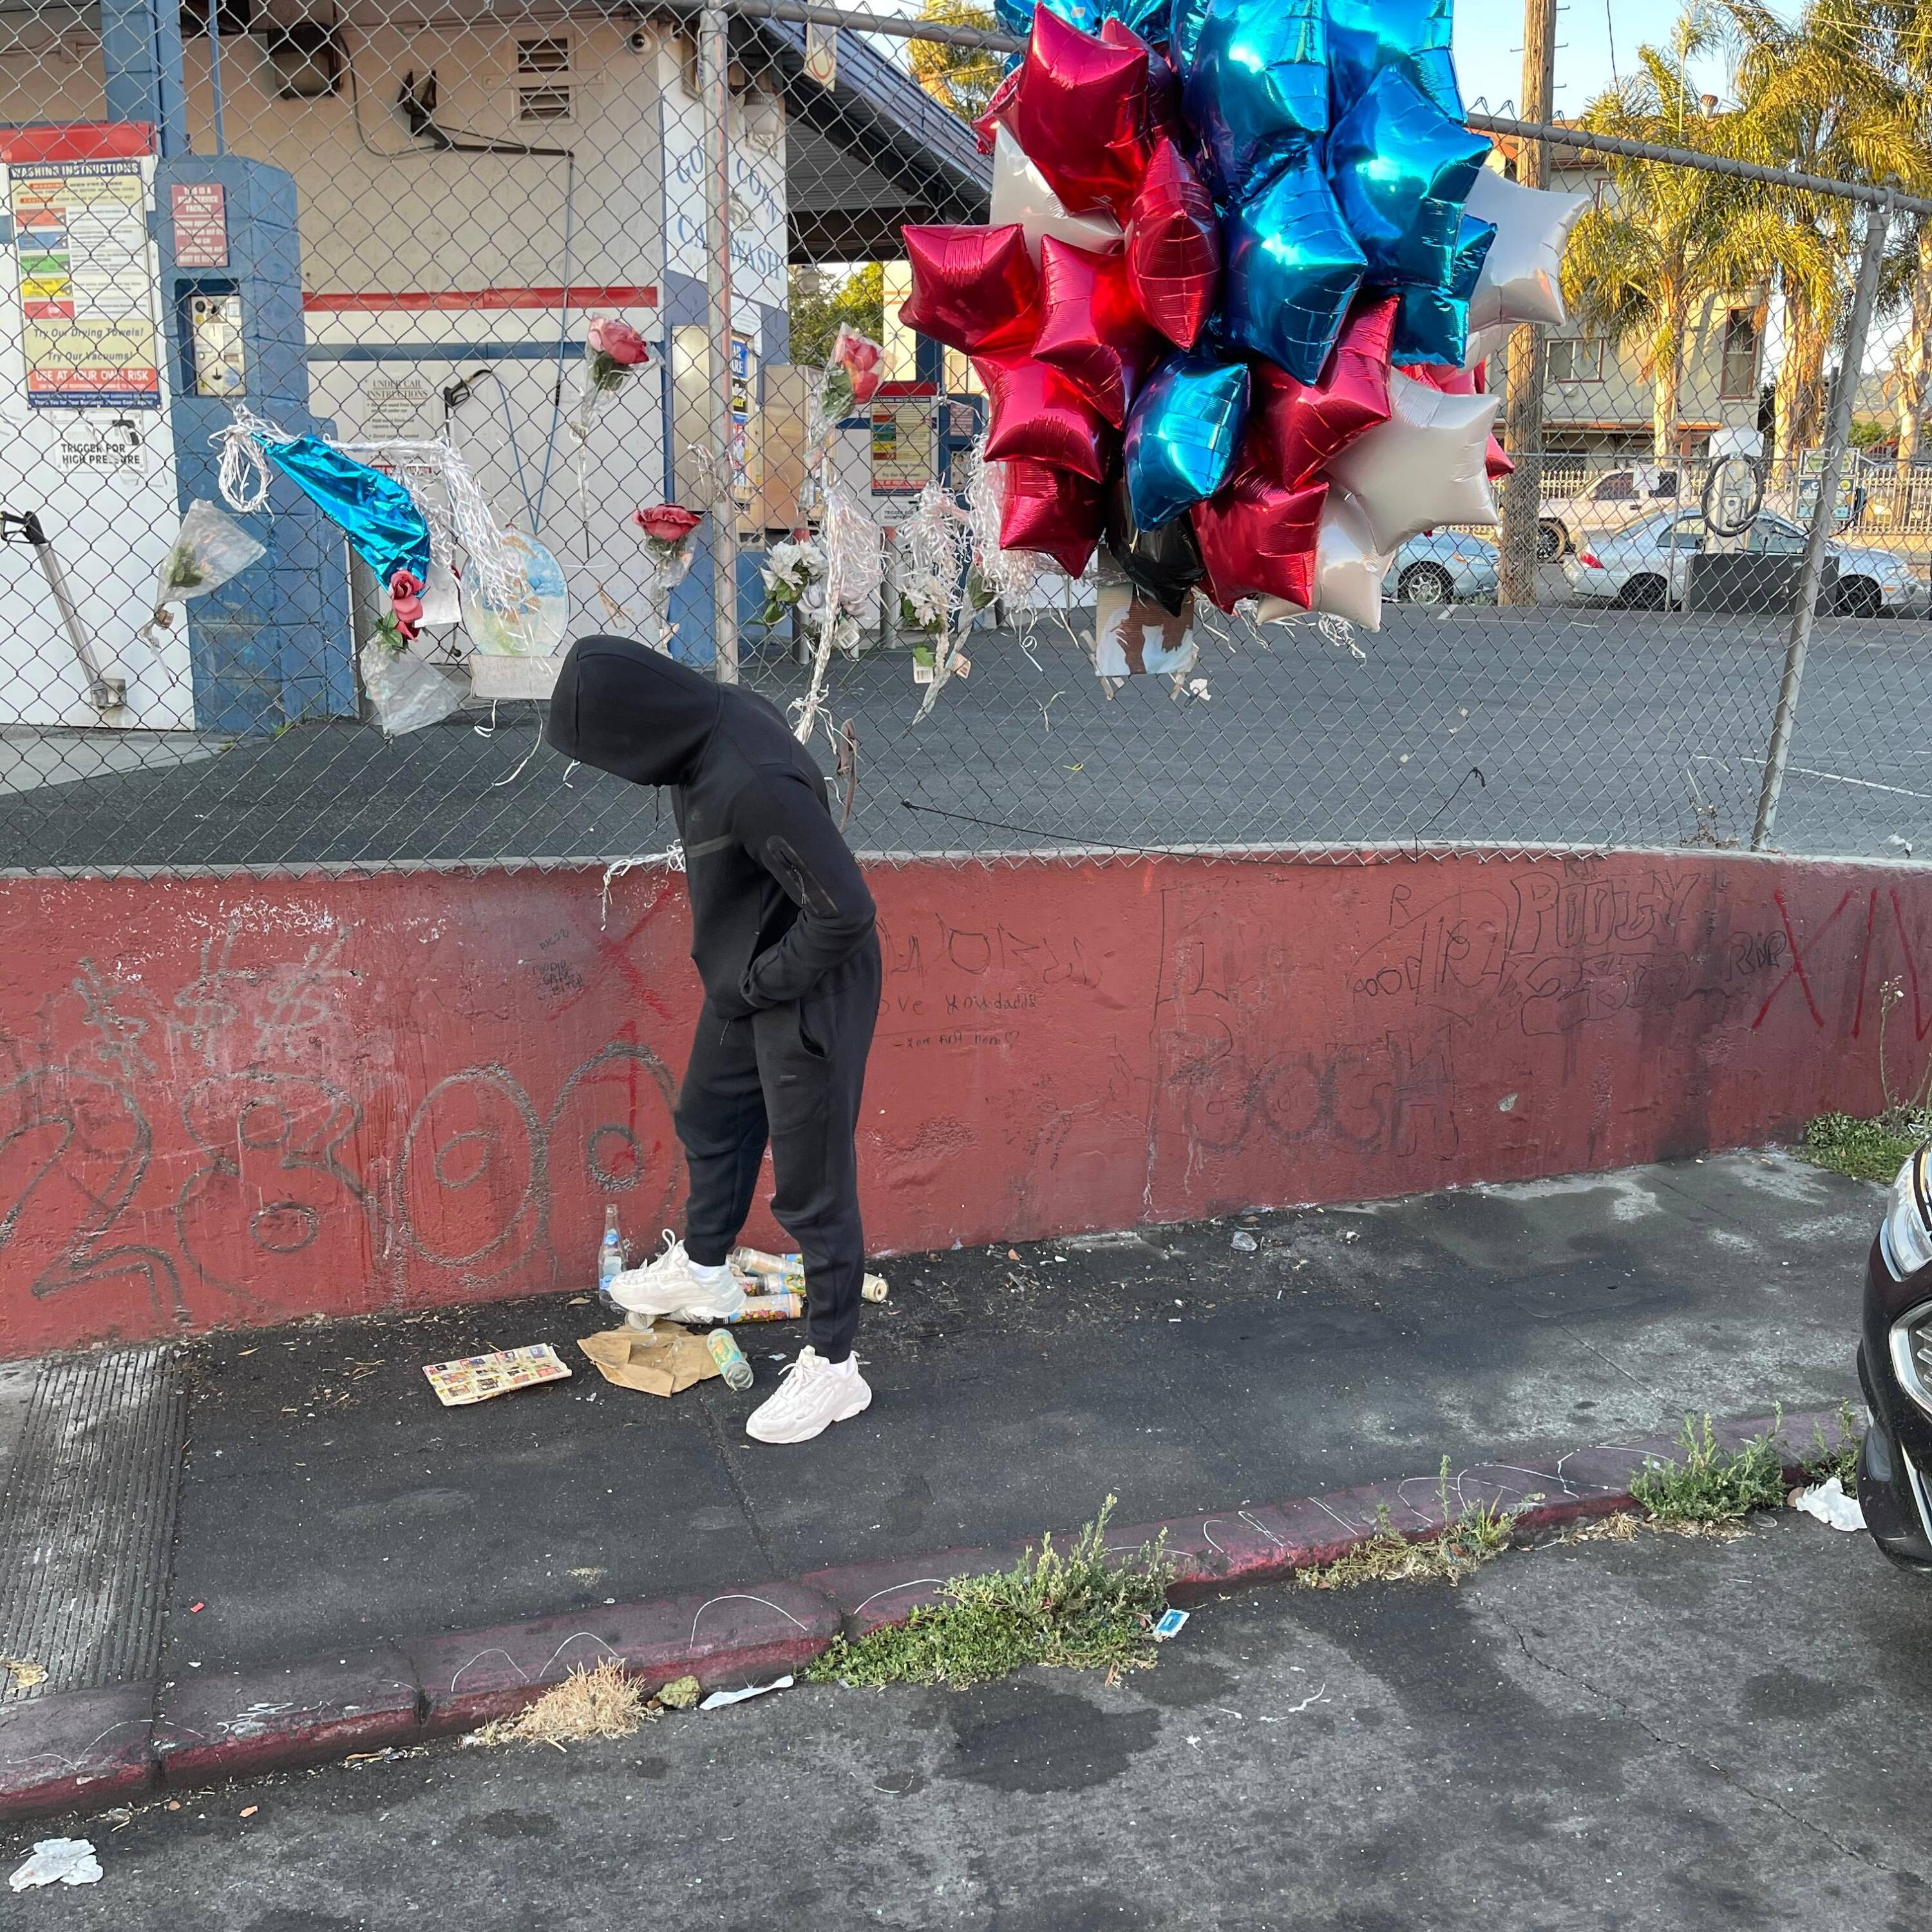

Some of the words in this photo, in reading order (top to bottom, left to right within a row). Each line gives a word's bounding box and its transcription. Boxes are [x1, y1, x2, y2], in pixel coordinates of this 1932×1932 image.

[12, 166, 59, 178] WASHING
[62, 162, 139, 176] INSTRUCTIONS
[730, 237, 780, 281] WASH
[34, 329, 47, 338] Try
[52, 328, 67, 337] Our
[71, 327, 102, 339] Drying
[107, 327, 144, 336] Towels!
[48, 352, 62, 363] Try
[66, 352, 82, 361] Our
[86, 352, 133, 361] Vacuums!
[35, 371, 54, 381] USE
[57, 370, 68, 380] AT
[72, 370, 97, 381] YOUR
[100, 370, 124, 381] OWN
[128, 370, 149, 381] RISK
[61, 444, 102, 453] TRIGGER
[106, 444, 125, 453] FOR
[62, 455, 85, 464] HIGH
[90, 455, 140, 464] PREURE
